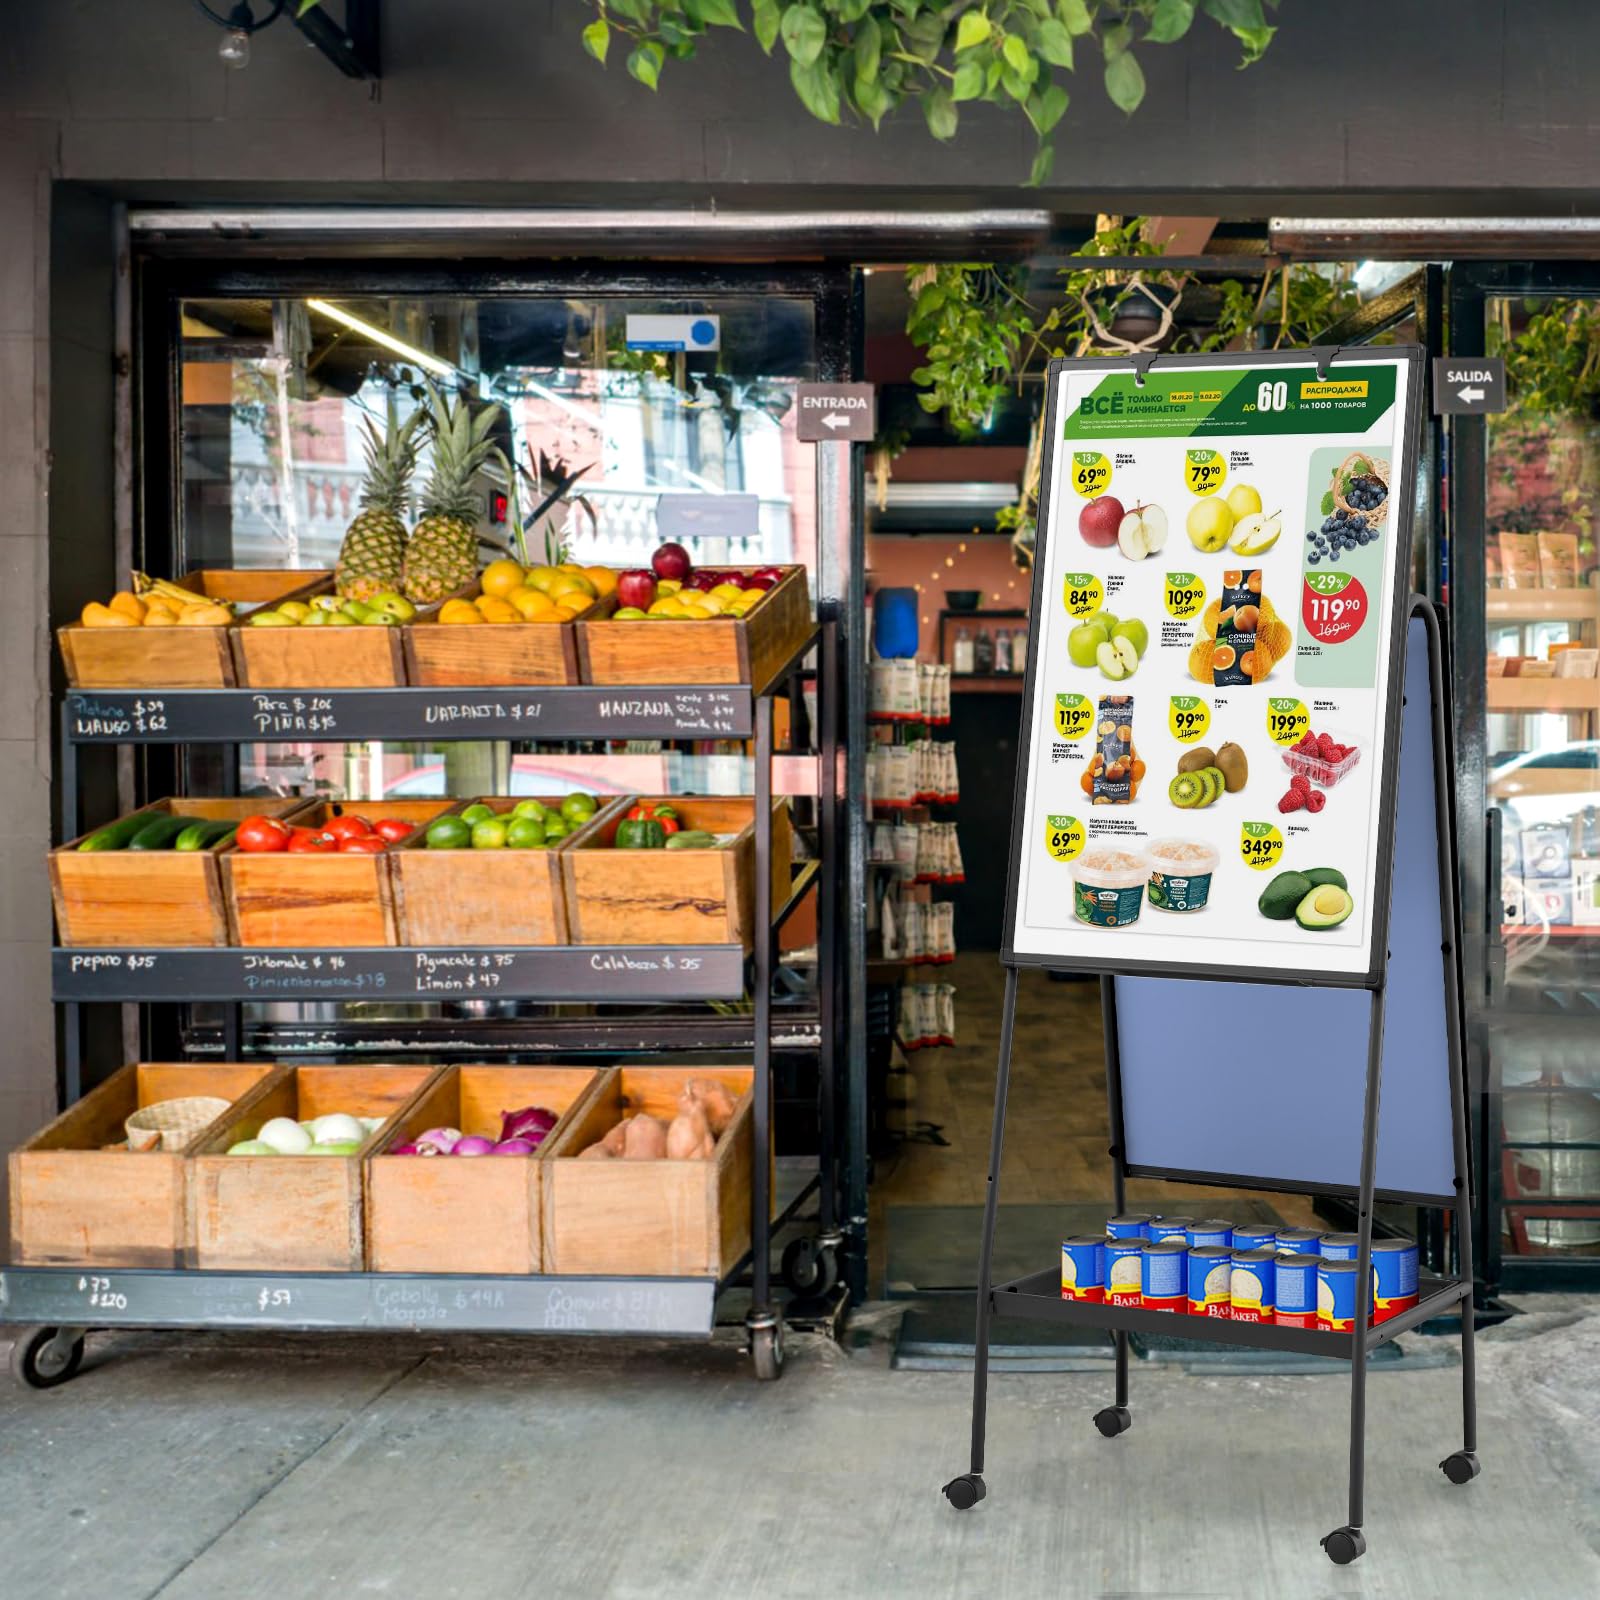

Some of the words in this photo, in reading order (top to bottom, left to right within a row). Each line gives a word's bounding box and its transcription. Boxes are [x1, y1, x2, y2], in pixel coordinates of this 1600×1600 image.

[1447, 370, 1493, 383] SALIDA
[1306, 386, 1363, 395] РАСПРОДАЖА
[803, 397, 867, 409] ENTRADA
[1080, 392, 1124, 415] ВСЁ
[1128, 395, 1163, 403] ТОЛЬКО
[1127, 405, 1186, 414] НАЧИНАЕТСЯ
